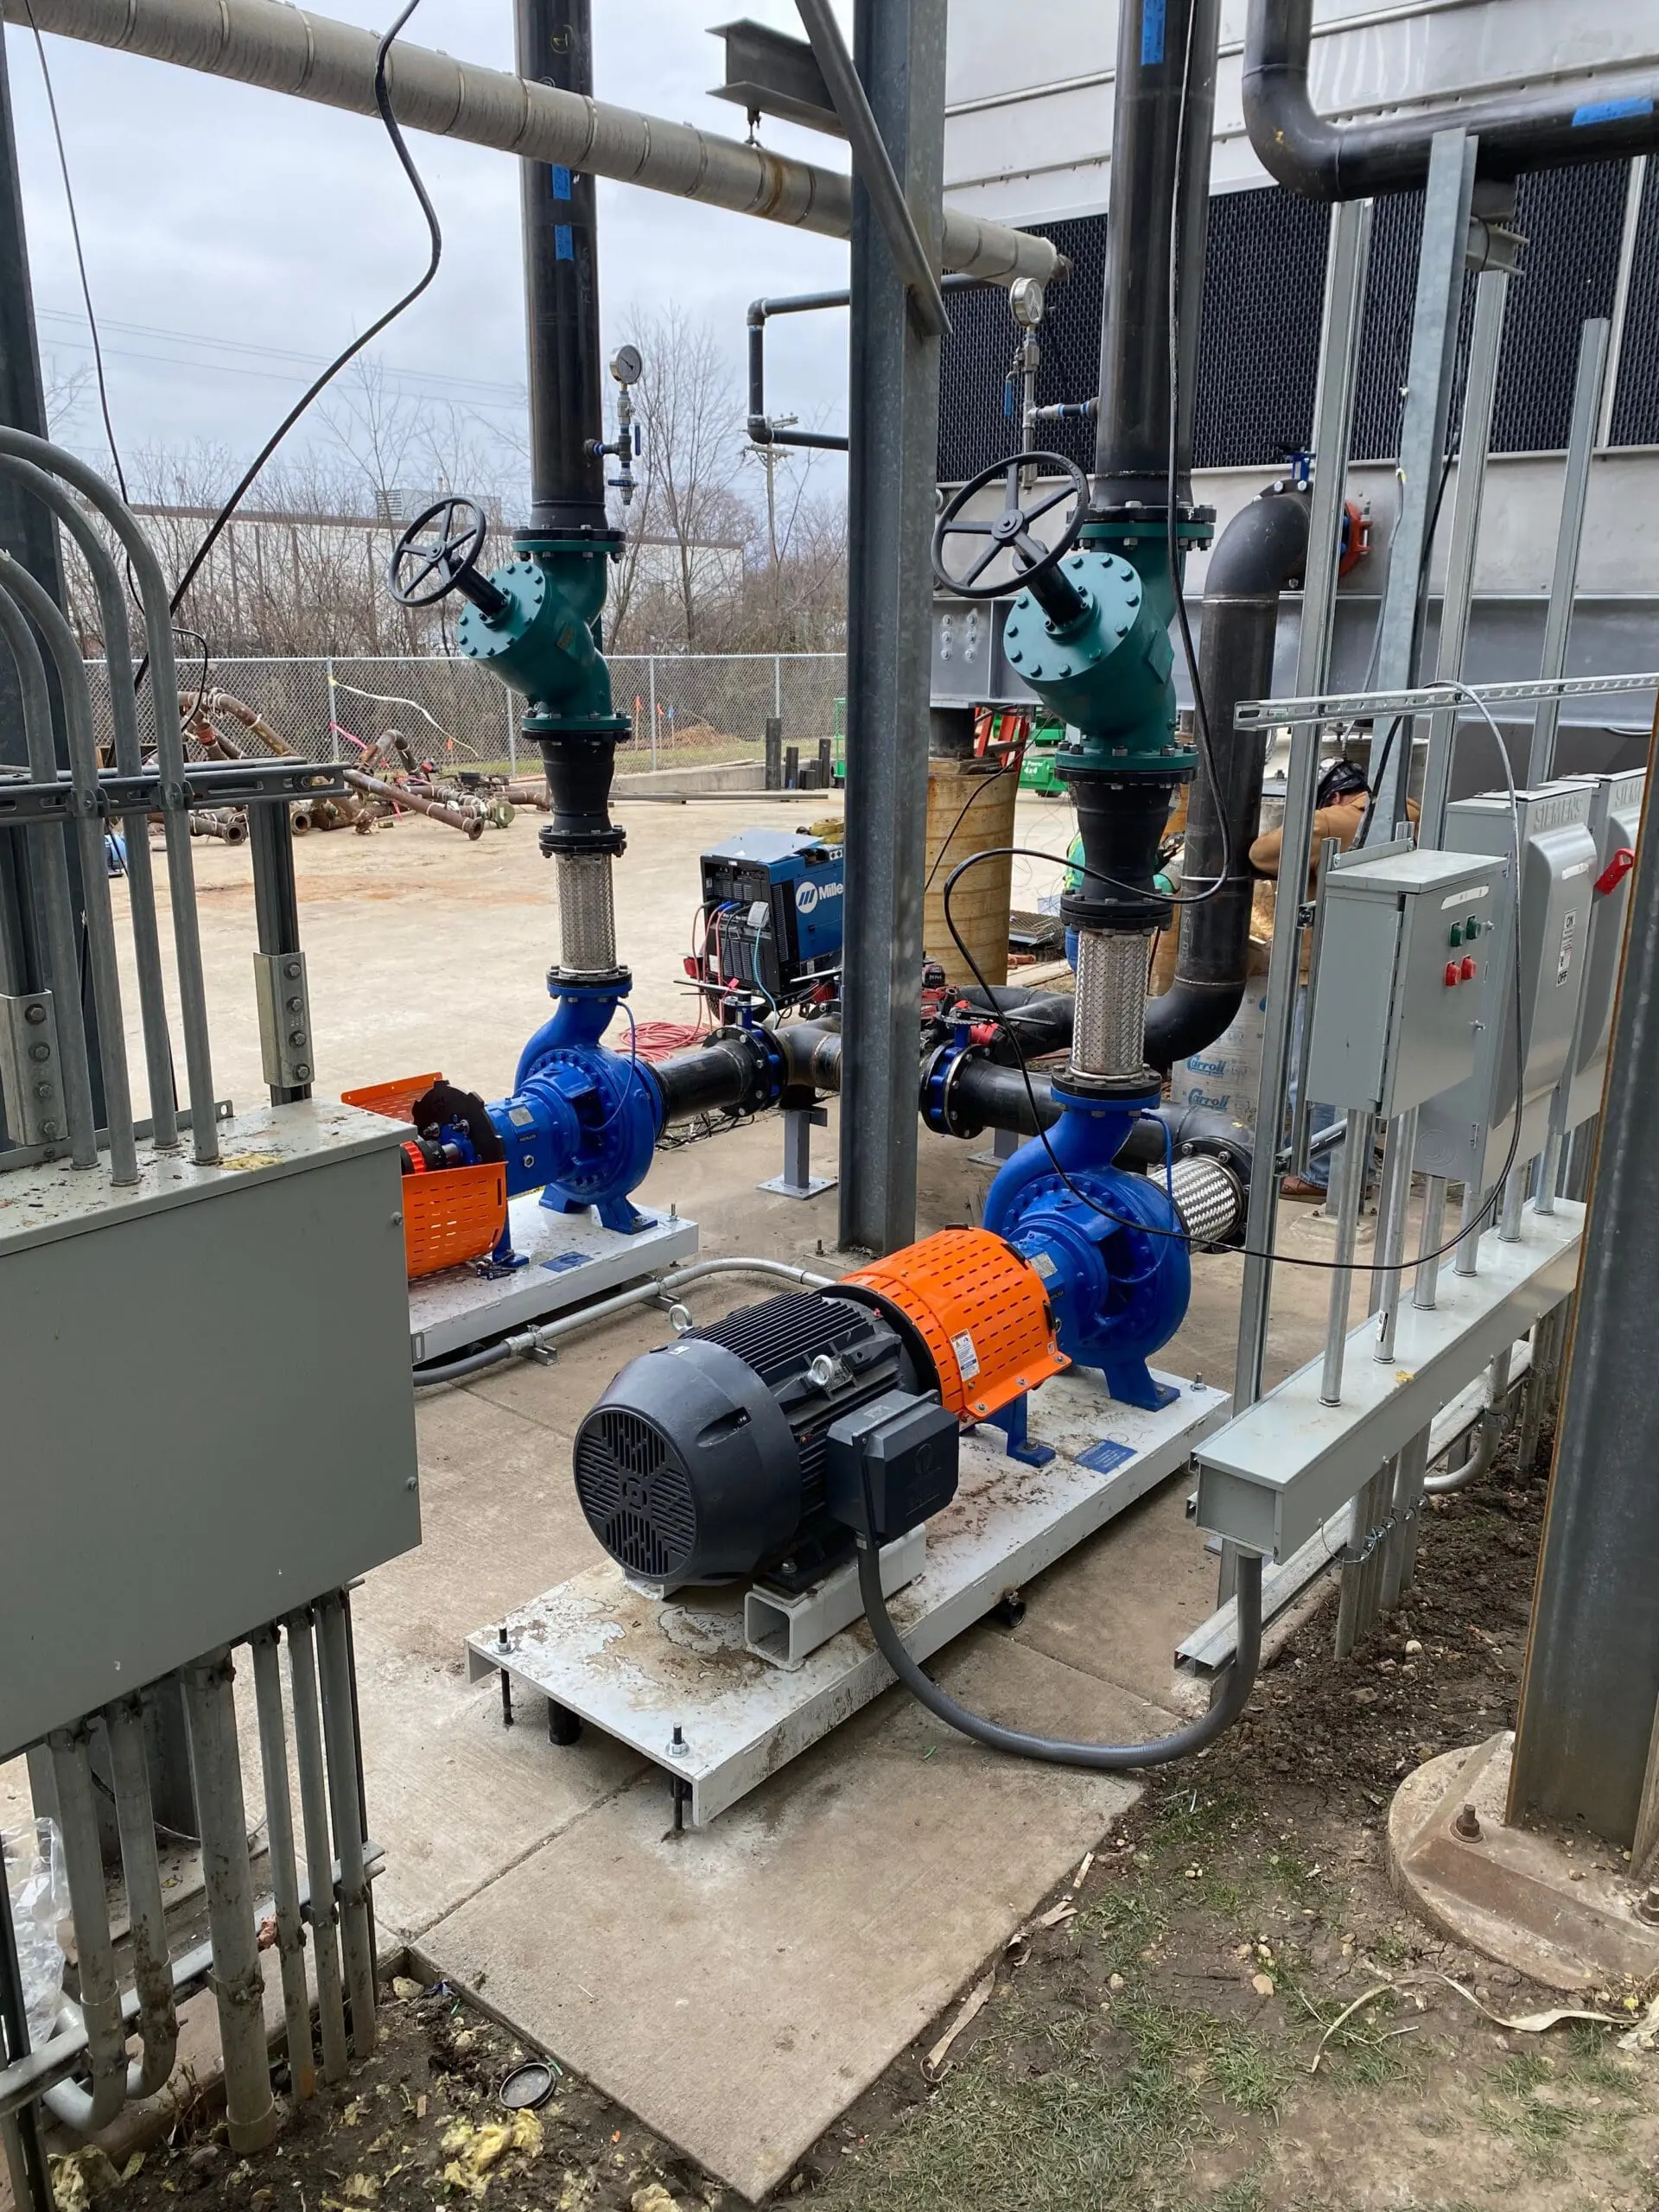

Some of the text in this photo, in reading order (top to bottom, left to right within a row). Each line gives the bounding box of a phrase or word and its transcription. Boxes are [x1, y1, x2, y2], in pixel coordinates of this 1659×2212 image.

[1535, 794, 1583, 830] SIEMENS
[818, 882, 843, 899] Mille
[1567, 916, 1573, 927] ON
[1557, 970, 1567, 984] OFF
[1187, 1054, 1227, 1075] Carroll
[1188, 1087, 1230, 1109] Carroll
